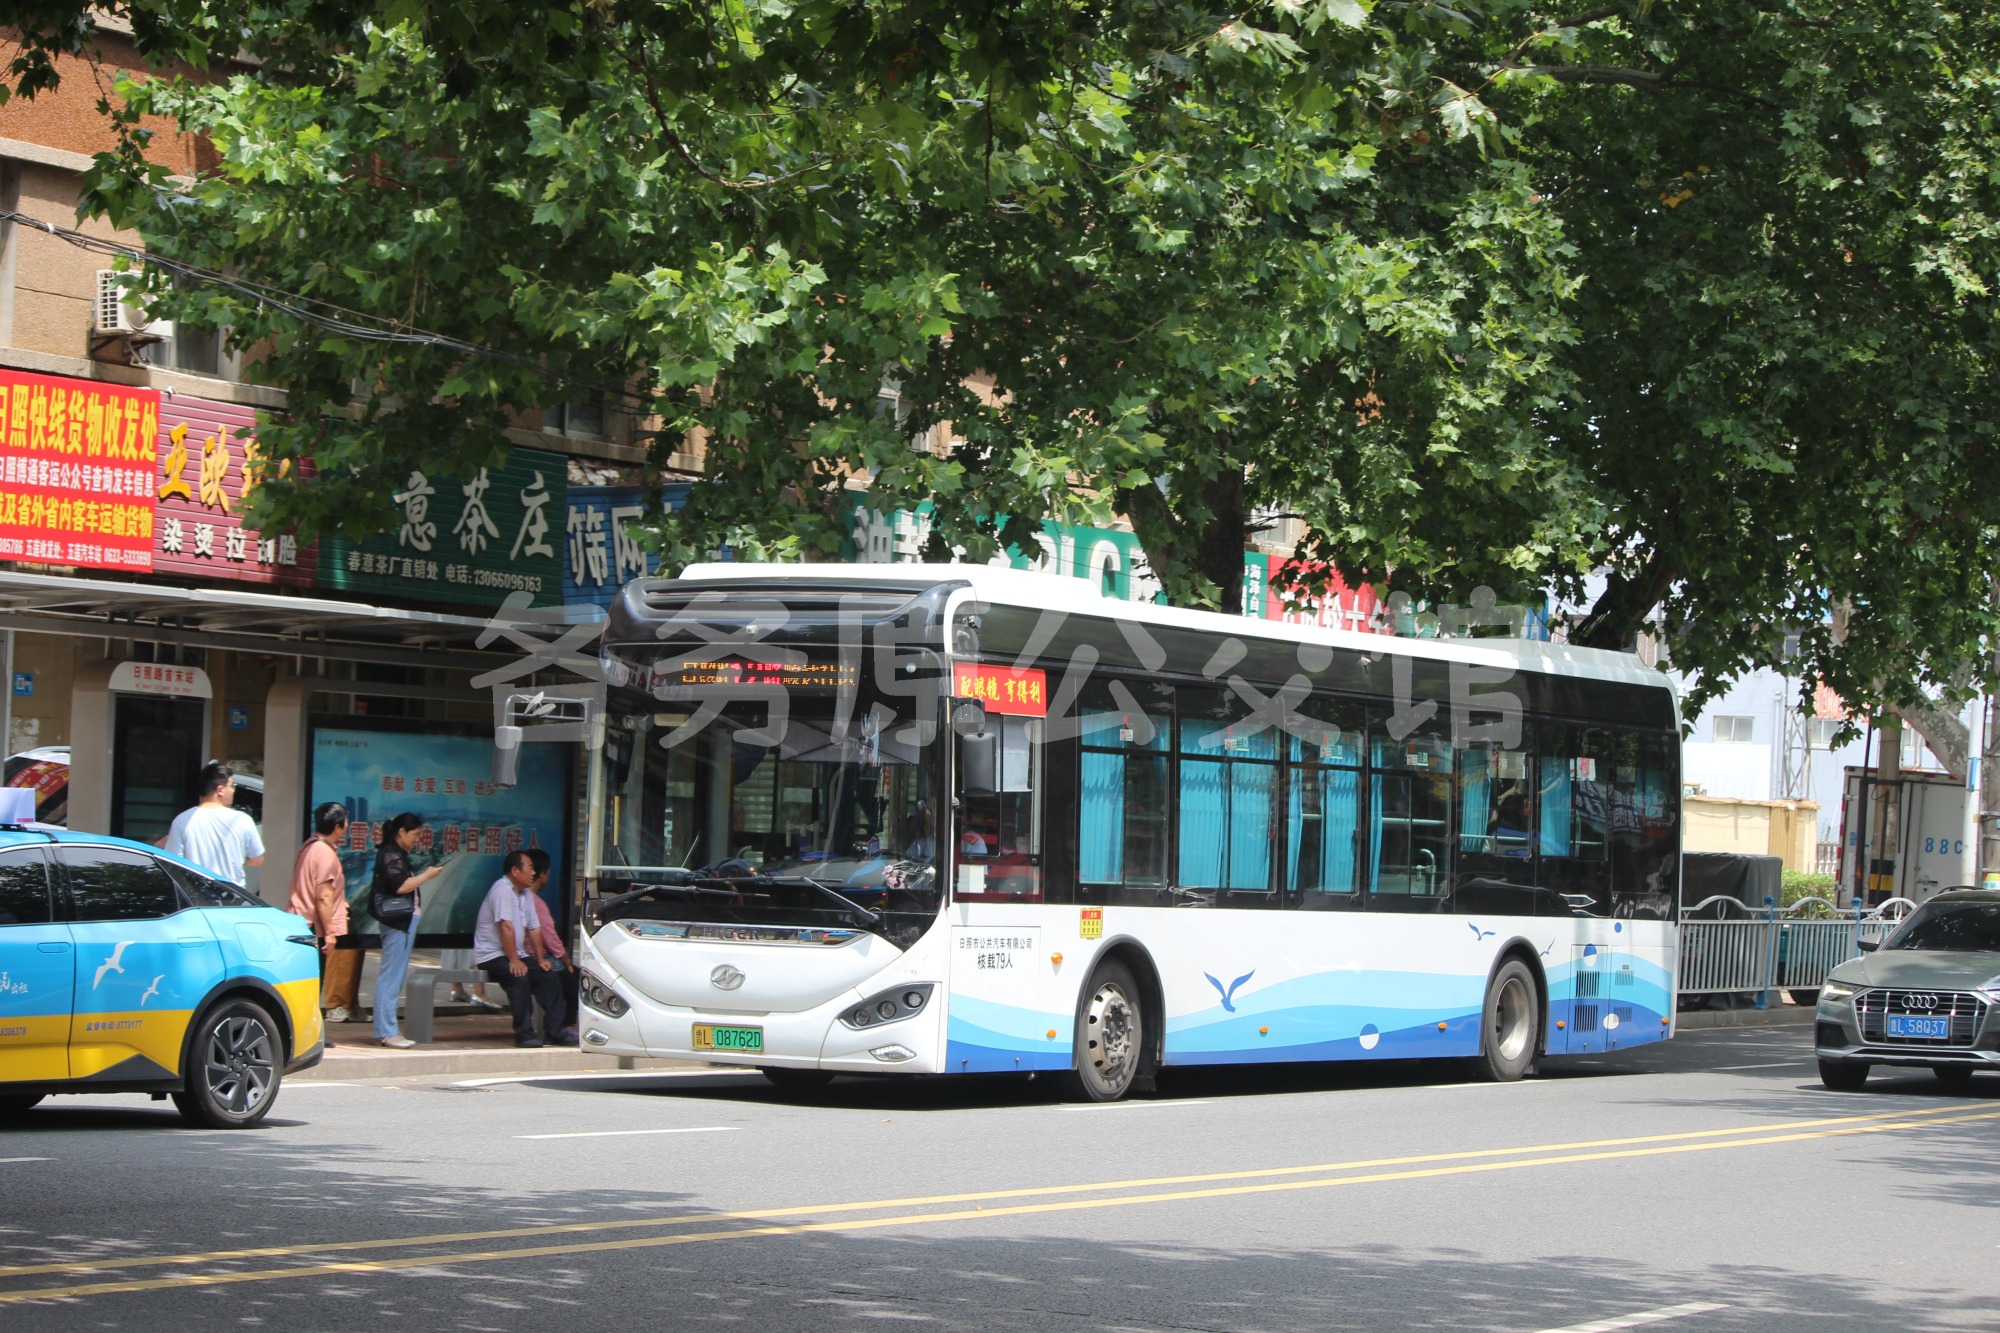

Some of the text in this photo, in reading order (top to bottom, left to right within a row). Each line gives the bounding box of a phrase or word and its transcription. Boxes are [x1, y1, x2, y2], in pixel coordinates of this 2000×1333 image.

[393, 467, 554, 561] 意茶庄
[960, 675, 1000, 701] 配眼镜
[959, 937, 1032, 950] 日照市公共汽车有限公司
[977, 952, 1013, 970] 核载79人
